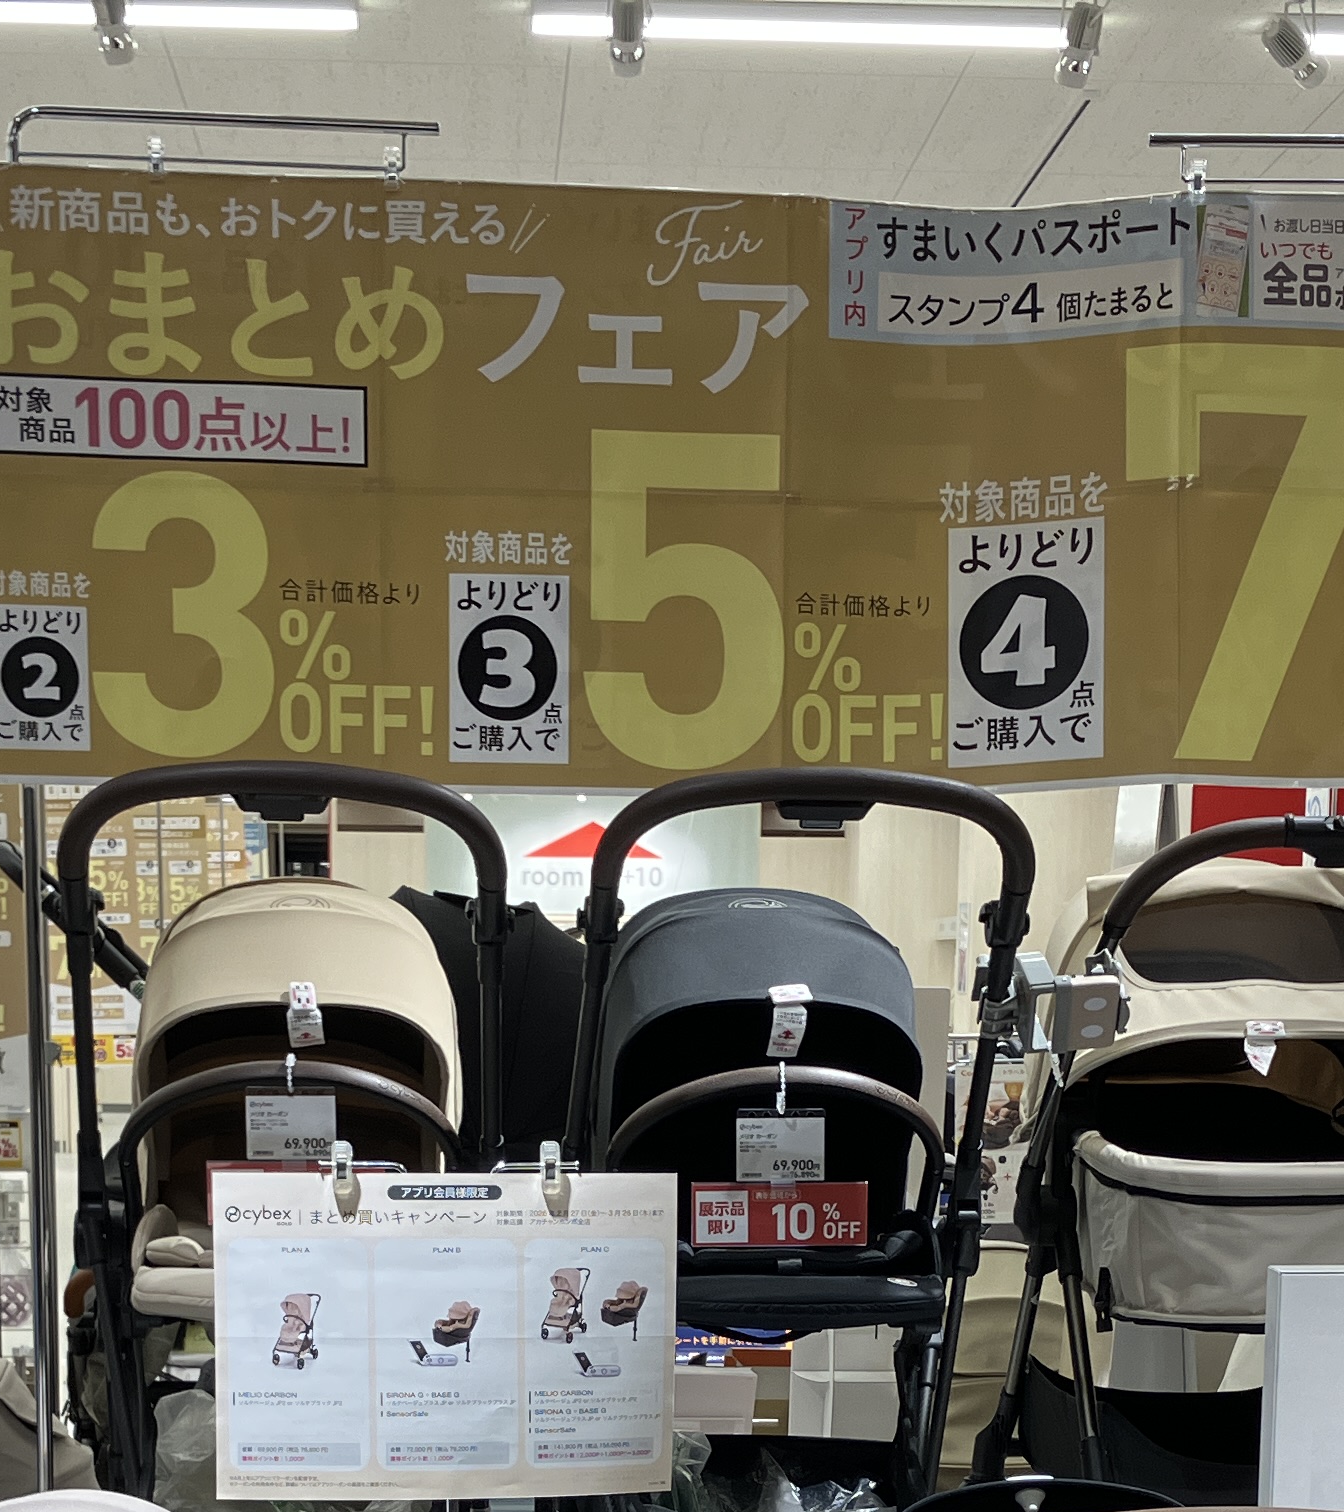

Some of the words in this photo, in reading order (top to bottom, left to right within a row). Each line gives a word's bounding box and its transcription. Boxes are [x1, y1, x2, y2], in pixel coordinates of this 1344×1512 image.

[10, 186, 506, 249] 新商品も、おトクに買える
[646, 200, 763, 286] Fair
[877, 208, 1191, 266] すまいくパスポート
[1260, 243, 1333, 260] いつでも
[844, 208, 867, 328] アプリ内
[1263, 261, 1332, 307] 全品
[19, 416, 75, 444] 商品
[74, 386, 353, 455] 100点以上!
[939, 472, 1108, 526] 対象商品を
[444, 530, 574, 568] 対象商品を
[958, 529, 1095, 573] よりどり
[279, 579, 421, 606] 合計価格より
[456, 580, 563, 613] よりどり
[582, 428, 784, 770] 5
[791, 694, 945, 765] OFF!
[796, 593, 931, 619] 合計価格より
[92, 470, 275, 759] 3
[279, 683, 434, 756] OFF!
[452, 725, 561, 752] ご購入で
[951, 713, 1092, 752] ご購入で
[521, 870, 583, 886] room
[773, 1160, 820, 1172] 69,900円
[401, 1186, 489, 1200] アプリ会員様限定
[699, 1202, 745, 1217] 展示品
[243, 1206, 291, 1225] cybex
[309, 1210, 486, 1226] まとめ買いキャンペーン
[708, 1220, 735, 1235] 限り
[772, 1202, 815, 1241] 10
[822, 1203, 840, 1220] %
[823, 1222, 861, 1239] OFF
